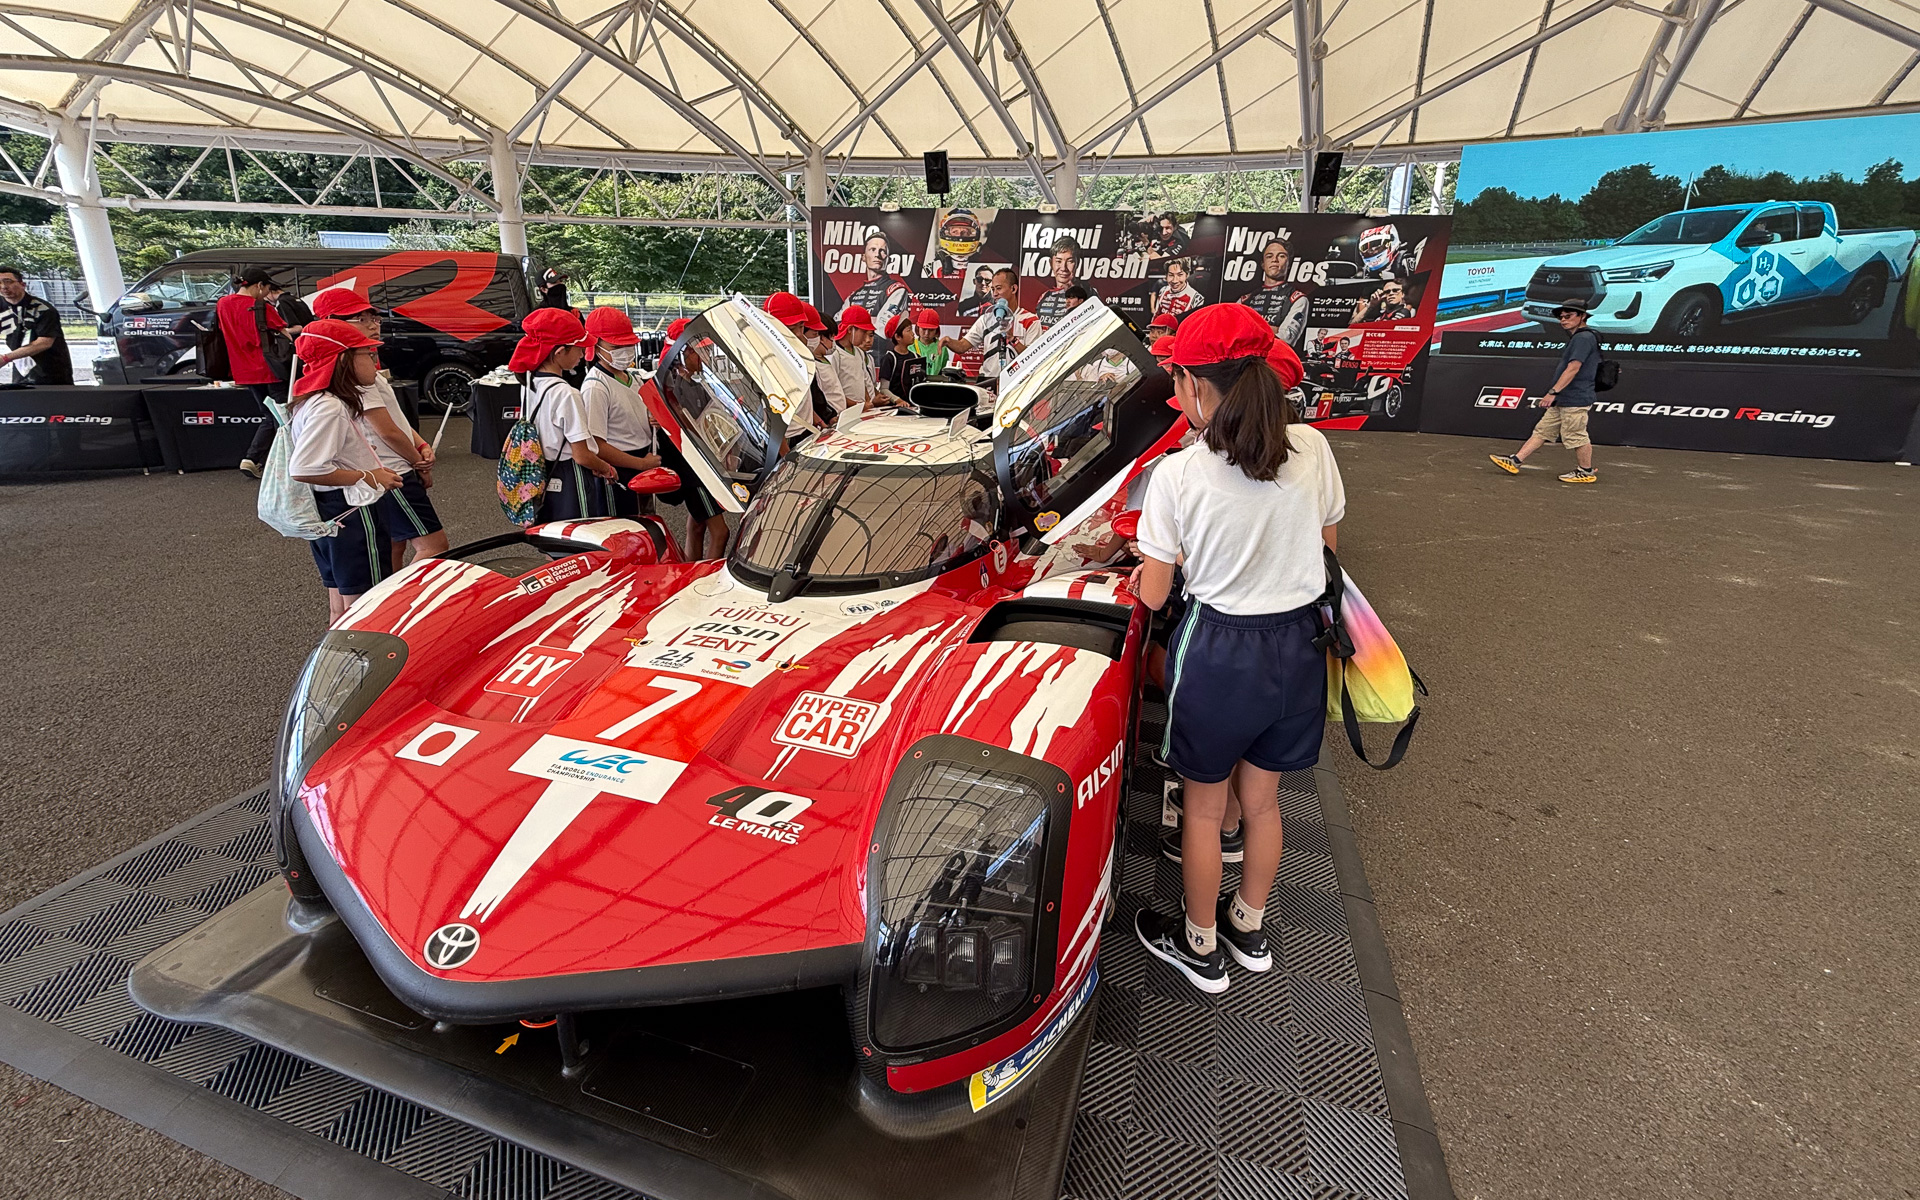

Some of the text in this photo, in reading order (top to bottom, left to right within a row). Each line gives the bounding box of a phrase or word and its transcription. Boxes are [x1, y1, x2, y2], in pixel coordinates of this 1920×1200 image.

[823, 249, 915, 277] Conay
[1021, 252, 1149, 280] Koyashi
[1224, 256, 1257, 281] de
[1467, 266, 1496, 277] TOYOTA
[124, 319, 146, 329] GR
[1020, 342, 1047, 365] TOYOTA
[1071, 304, 1095, 324] Racing
[49, 414, 113, 426] Racing
[184, 416, 213, 424] GR
[1476, 394, 1836, 429] GR TTA GAZOO Racing
[828, 437, 932, 455] DENSO
[549, 559, 577, 573] TOYOTA
[552, 564, 578, 578] GAZOO
[578, 555, 592, 570] 7
[526, 574, 556, 594] GR
[555, 568, 581, 582] Racing
[709, 607, 802, 627] FUJITSU
[847, 604, 875, 614] FIA
[682, 634, 757, 653] ZENT
[496, 653, 573, 687] HY
[594, 675, 703, 741] 7
[798, 696, 870, 722] HYPER
[784, 712, 860, 750] CAR
[559, 749, 648, 774] WEC
[547, 768, 596, 782] CHAMPIONSHIP
[562, 766, 586, 775] WORLD
[586, 770, 626, 784] ENDURANCE
[705, 785, 813, 826] 40
[708, 815, 738, 829] LE
[1020, 971, 1093, 1065] MICHELIN
